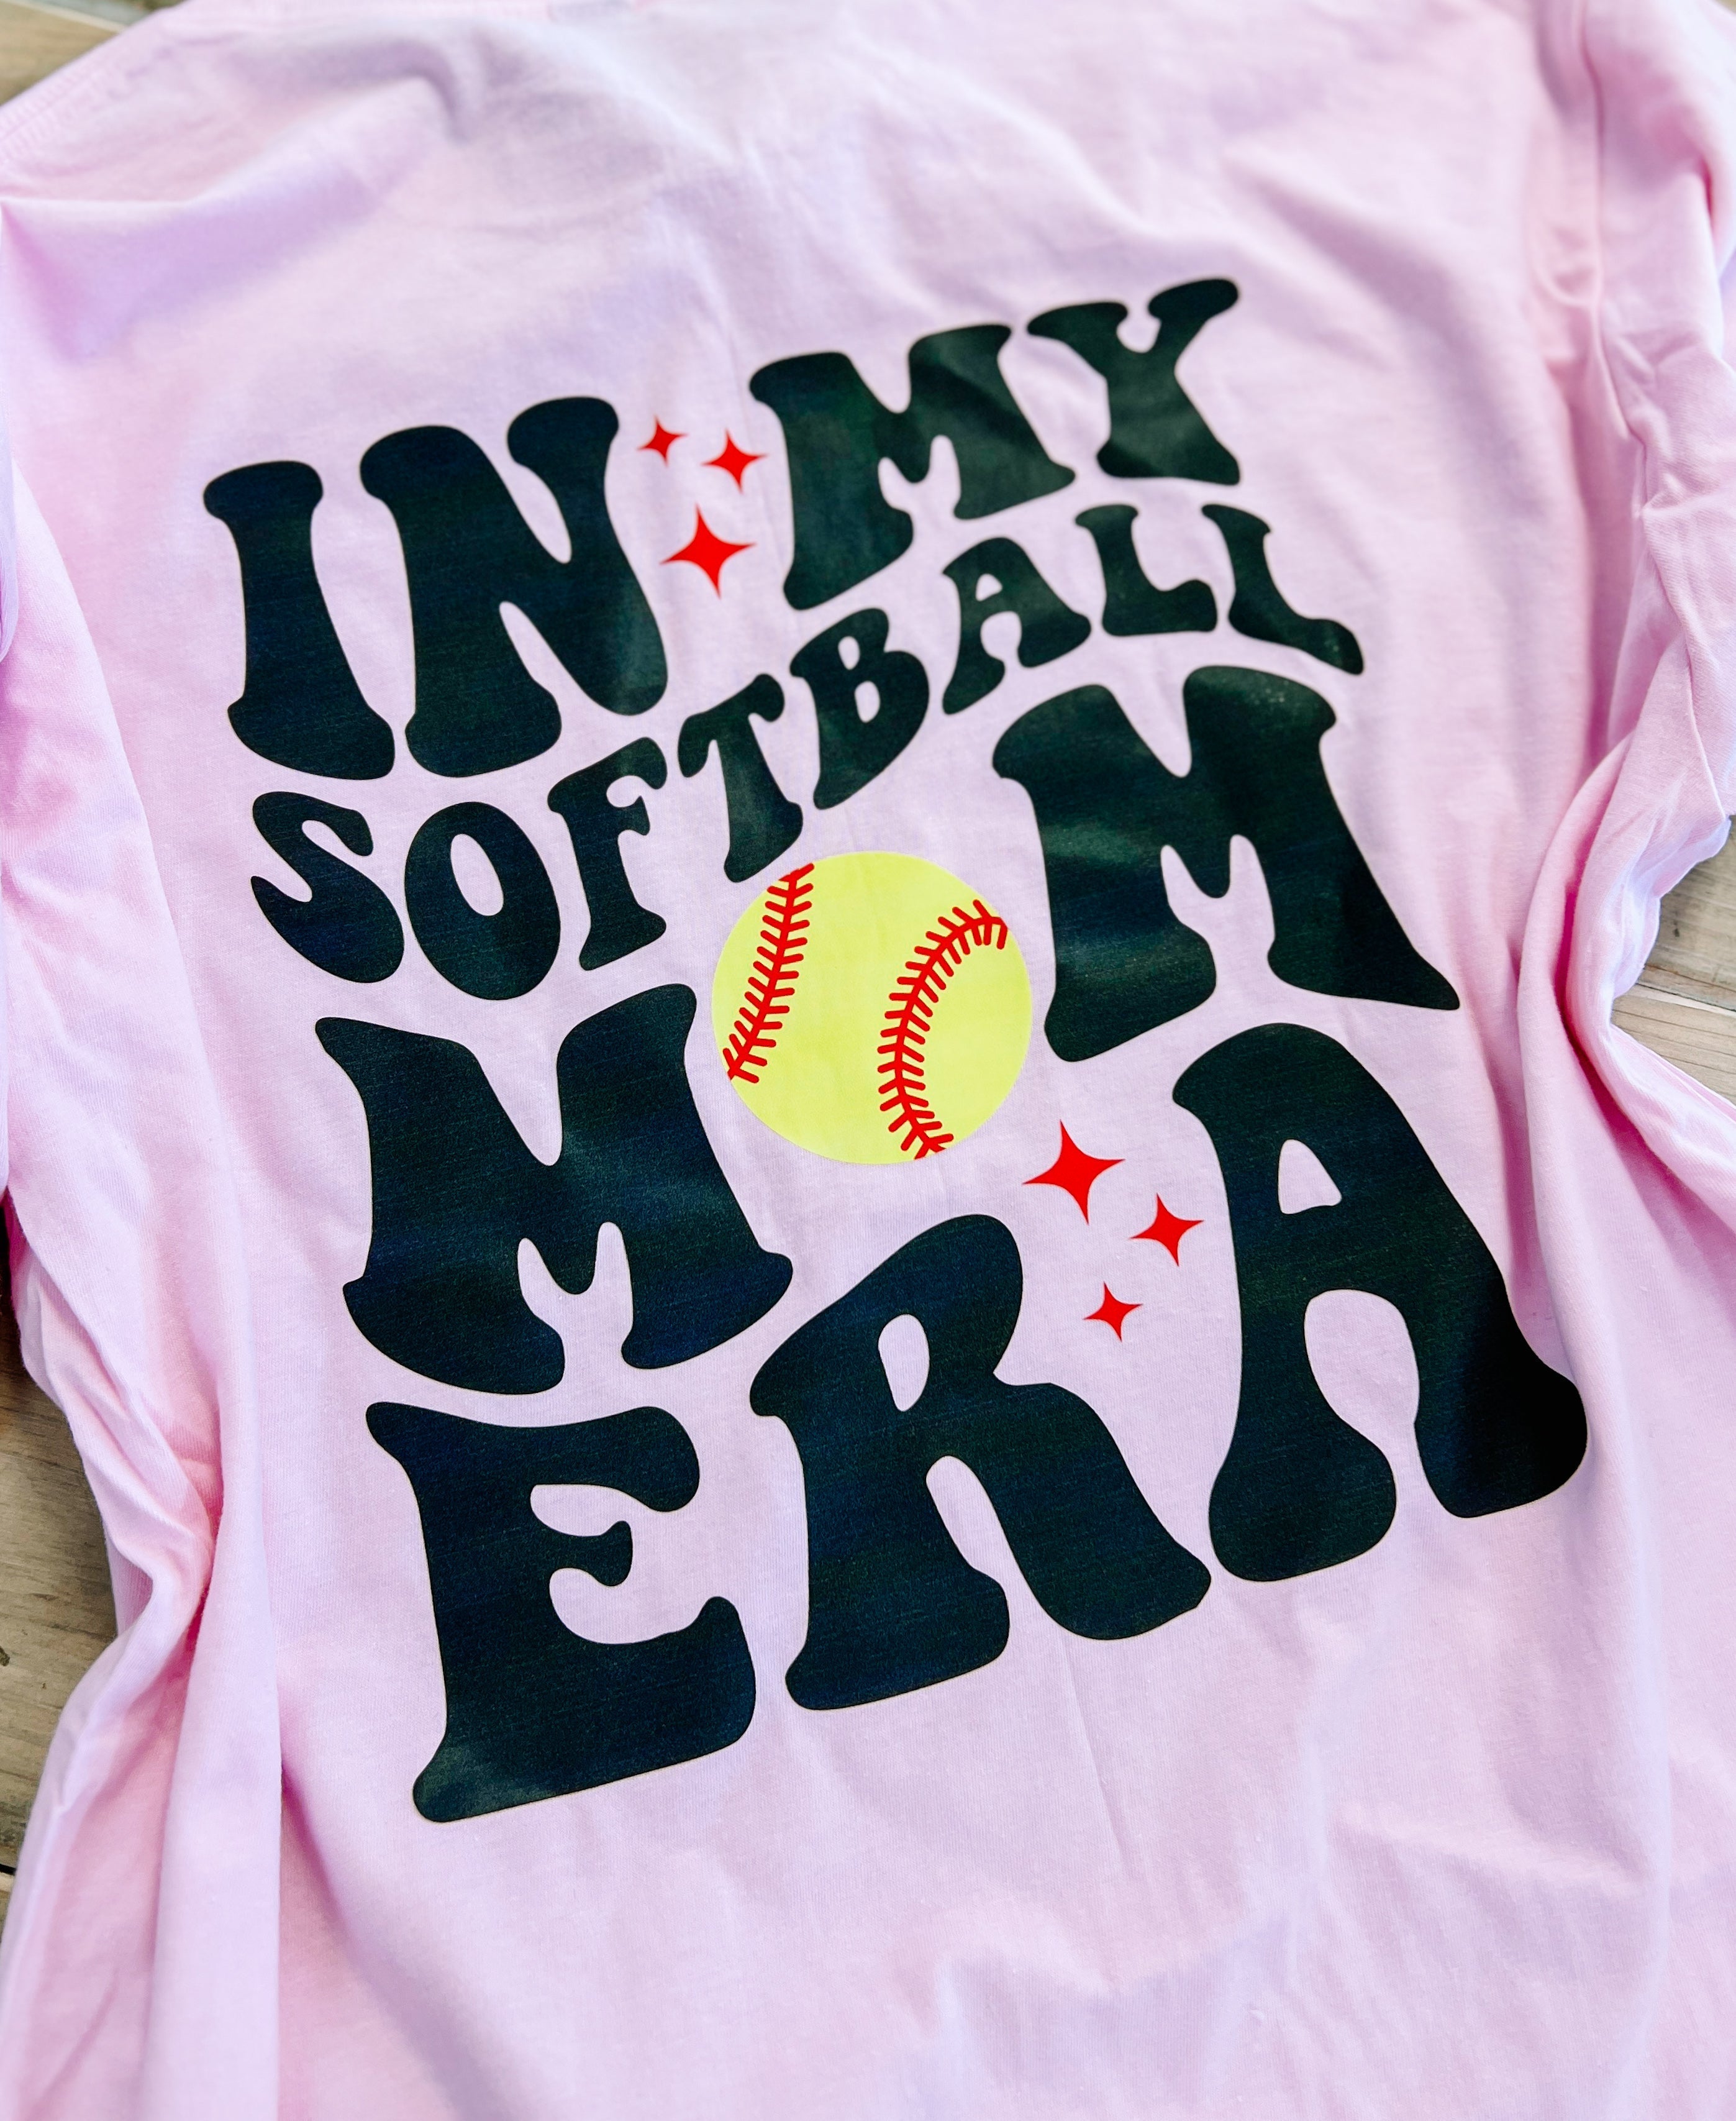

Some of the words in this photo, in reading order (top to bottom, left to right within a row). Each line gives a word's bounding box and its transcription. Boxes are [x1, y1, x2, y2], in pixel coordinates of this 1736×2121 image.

[203, 396, 668, 780] IN
[749, 278, 1240, 611] MY
[251, 504, 1364, 1000] SOFTBALL
[366, 1023, 1588, 1823] ERA
